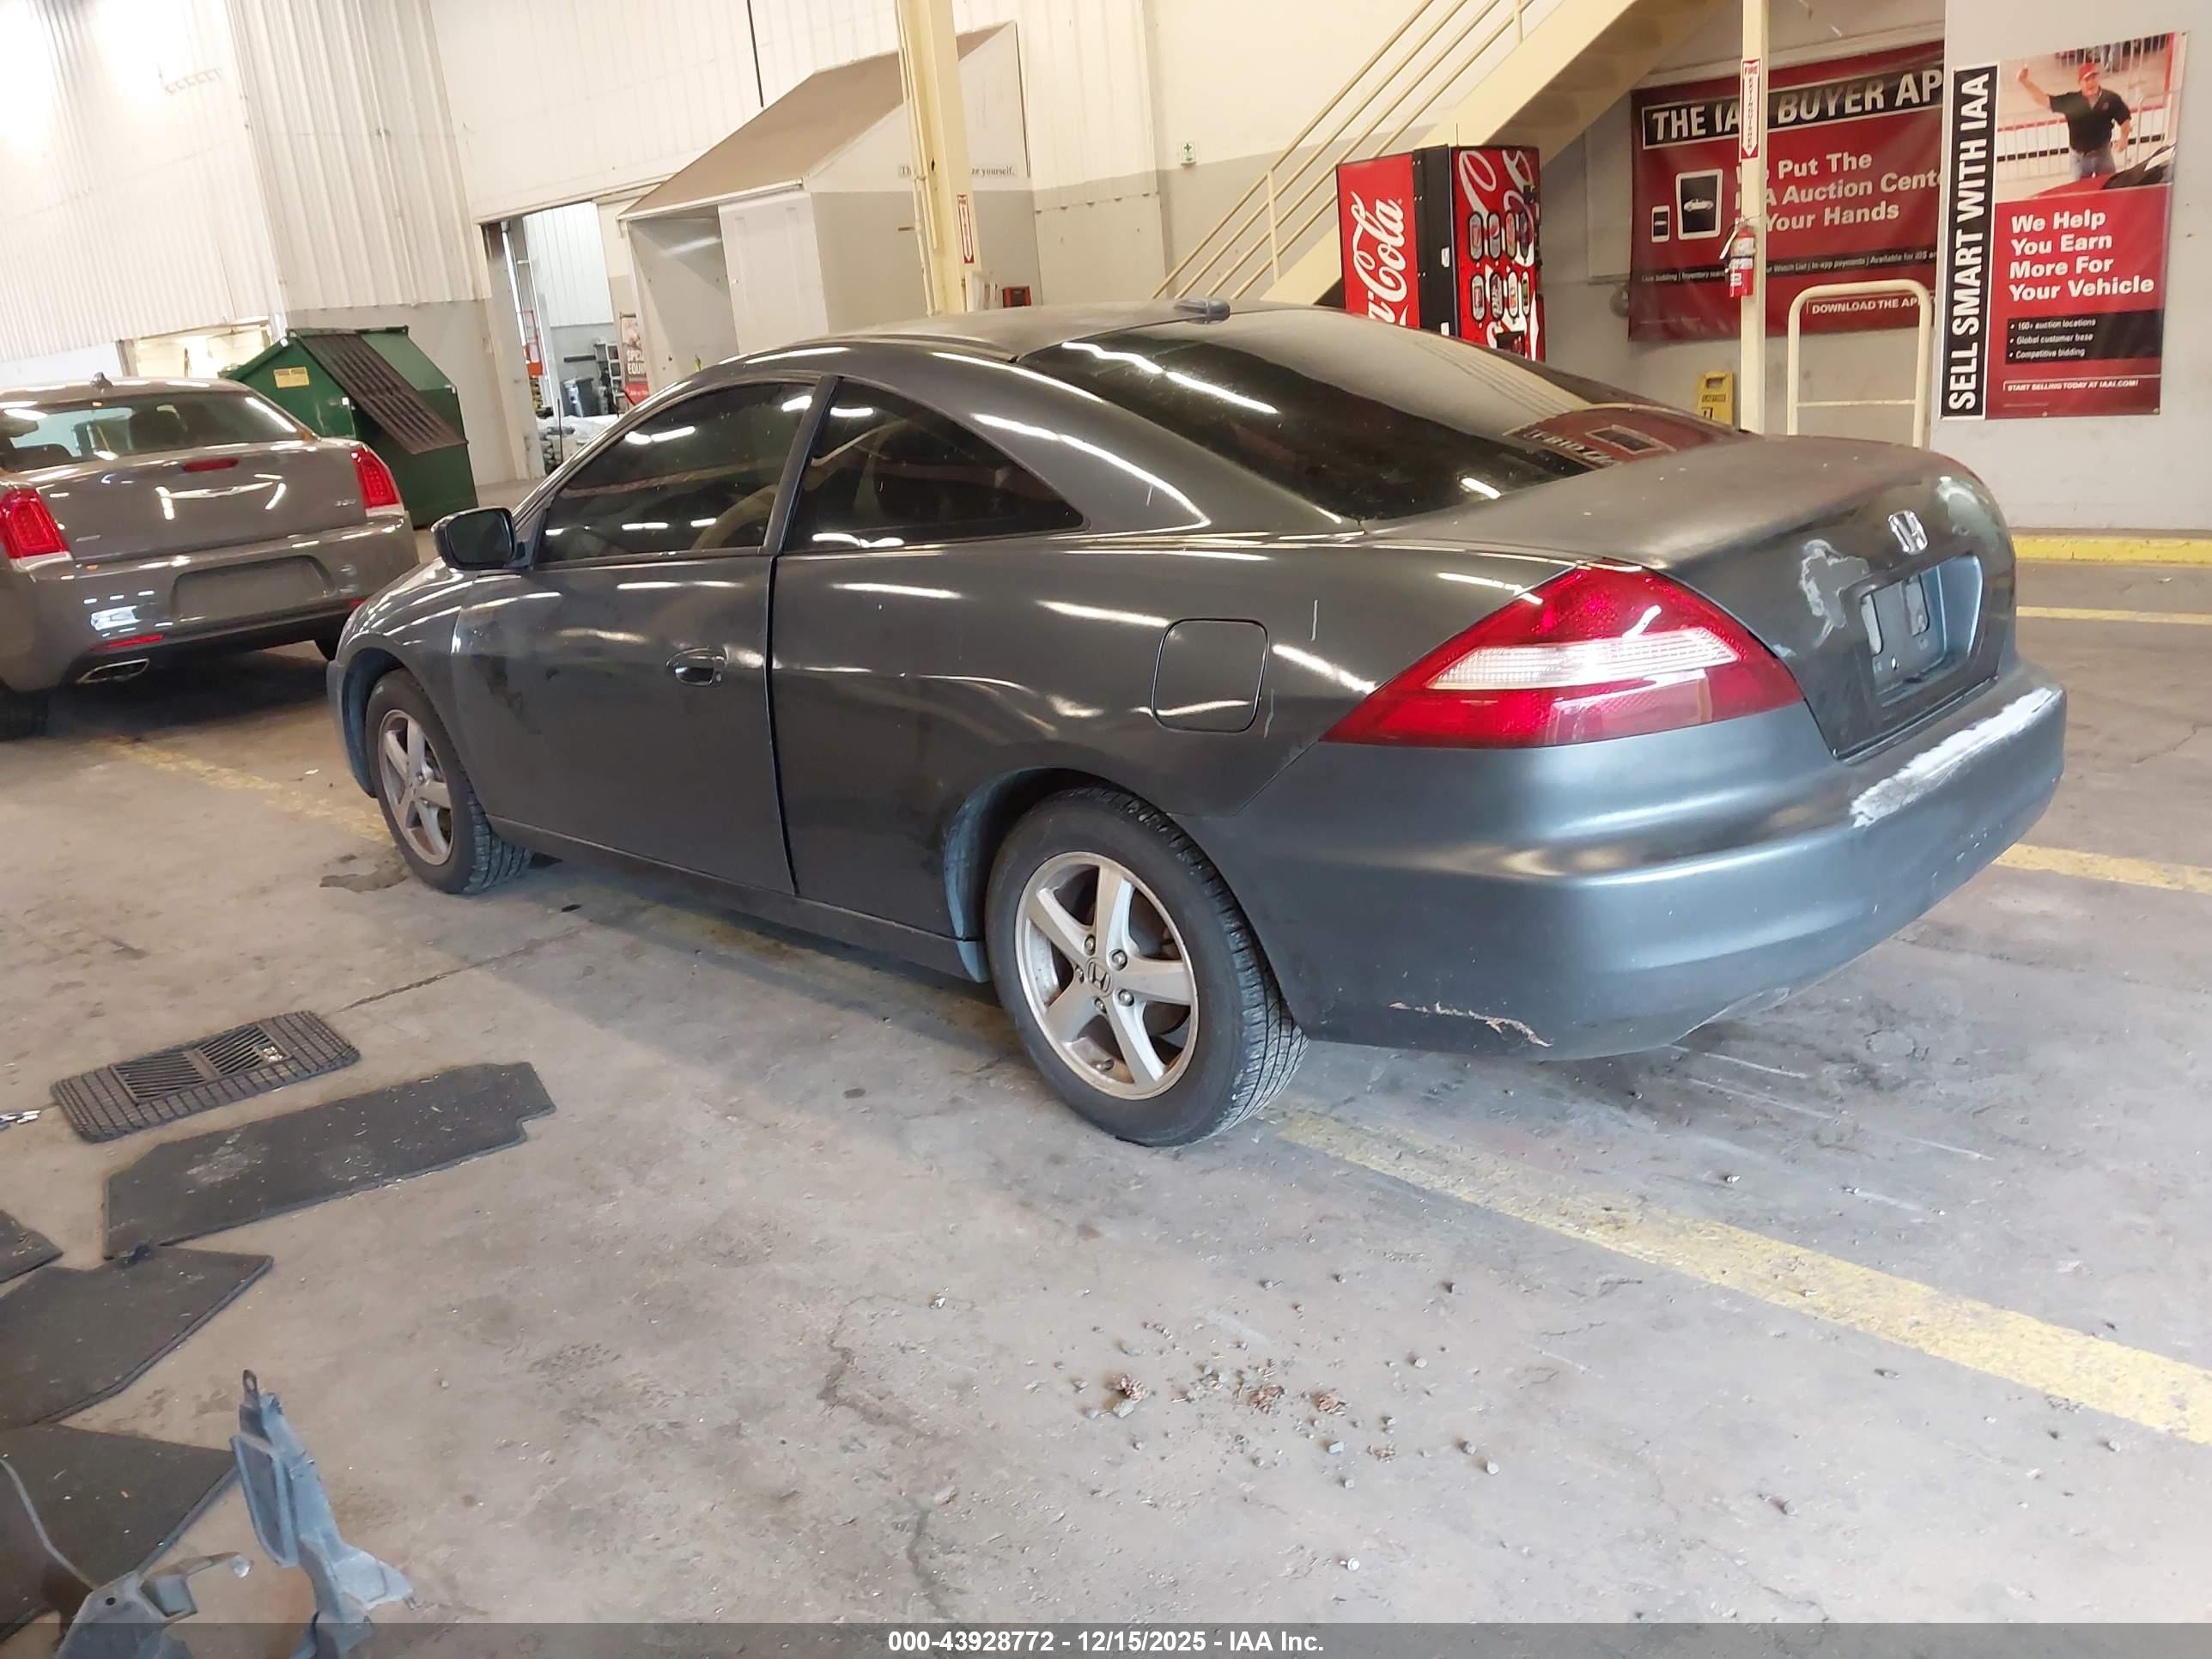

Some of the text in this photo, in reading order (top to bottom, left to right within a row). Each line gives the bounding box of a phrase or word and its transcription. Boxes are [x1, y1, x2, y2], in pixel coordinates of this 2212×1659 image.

[1744, 65, 1758, 75] FIRE
[1652, 106, 1706, 141] THE
[1778, 79, 1885, 125] BUYER
[981, 165, 1015, 178] yourself.
[1778, 158, 1819, 179] Put
[1826, 151, 1872, 173] The
[1782, 179, 1873, 205] Auction
[1881, 169, 1941, 192] Cent
[1766, 200, 1899, 233] Your Hands
[2011, 209, 2106, 234] We Help
[1948, 73, 1990, 410] SELL SMART WITH IAA
[2010, 234, 2112, 257] You Earn
[2009, 255, 2114, 280] More For
[2008, 275, 2154, 301] Your Vehicle
[1812, 300, 1876, 314] DOWNLOAD
[1878, 298, 1899, 309] THE
[2034, 320, 2062, 330] auction
[2062, 318, 2096, 327] locations
[2016, 335, 2039, 345] Global
[2057, 348, 2086, 357] bidding
[2063, 381, 2087, 390] TODAY
